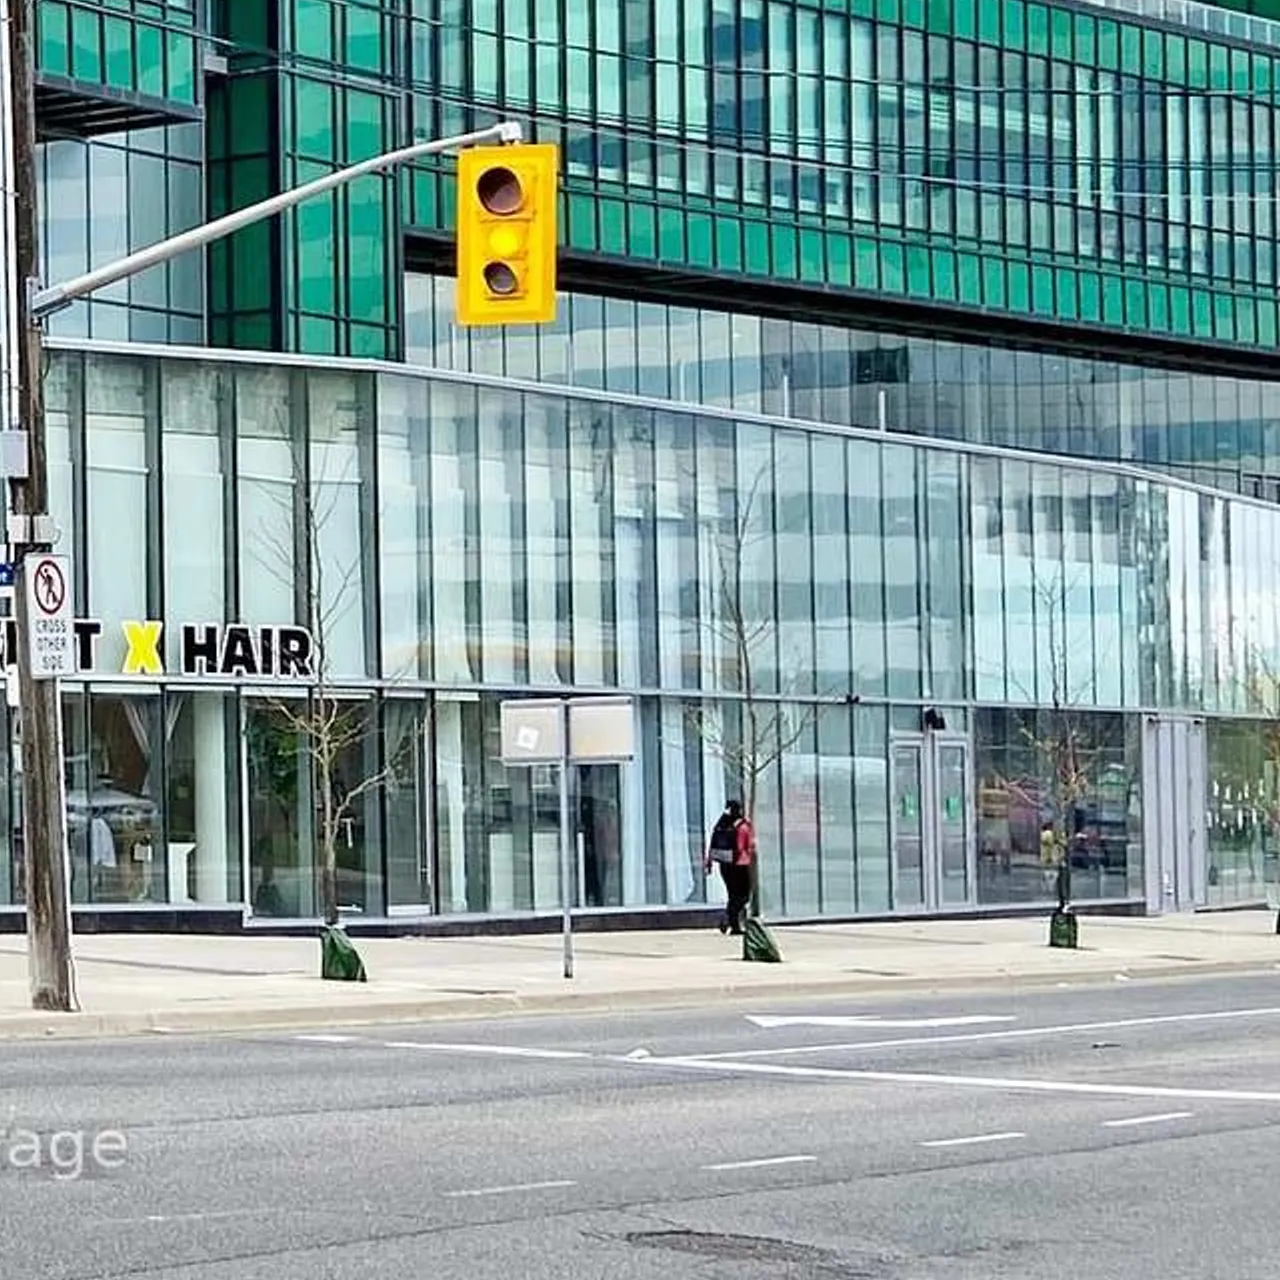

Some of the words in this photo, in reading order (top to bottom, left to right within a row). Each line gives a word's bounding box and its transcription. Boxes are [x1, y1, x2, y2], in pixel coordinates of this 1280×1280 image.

[36, 619, 67, 634] CROSS
[37, 636, 67, 652] OTHER
[123, 620, 162, 673] X
[182, 624, 313, 675] HAIR
[42, 655, 64, 670] SIDE
